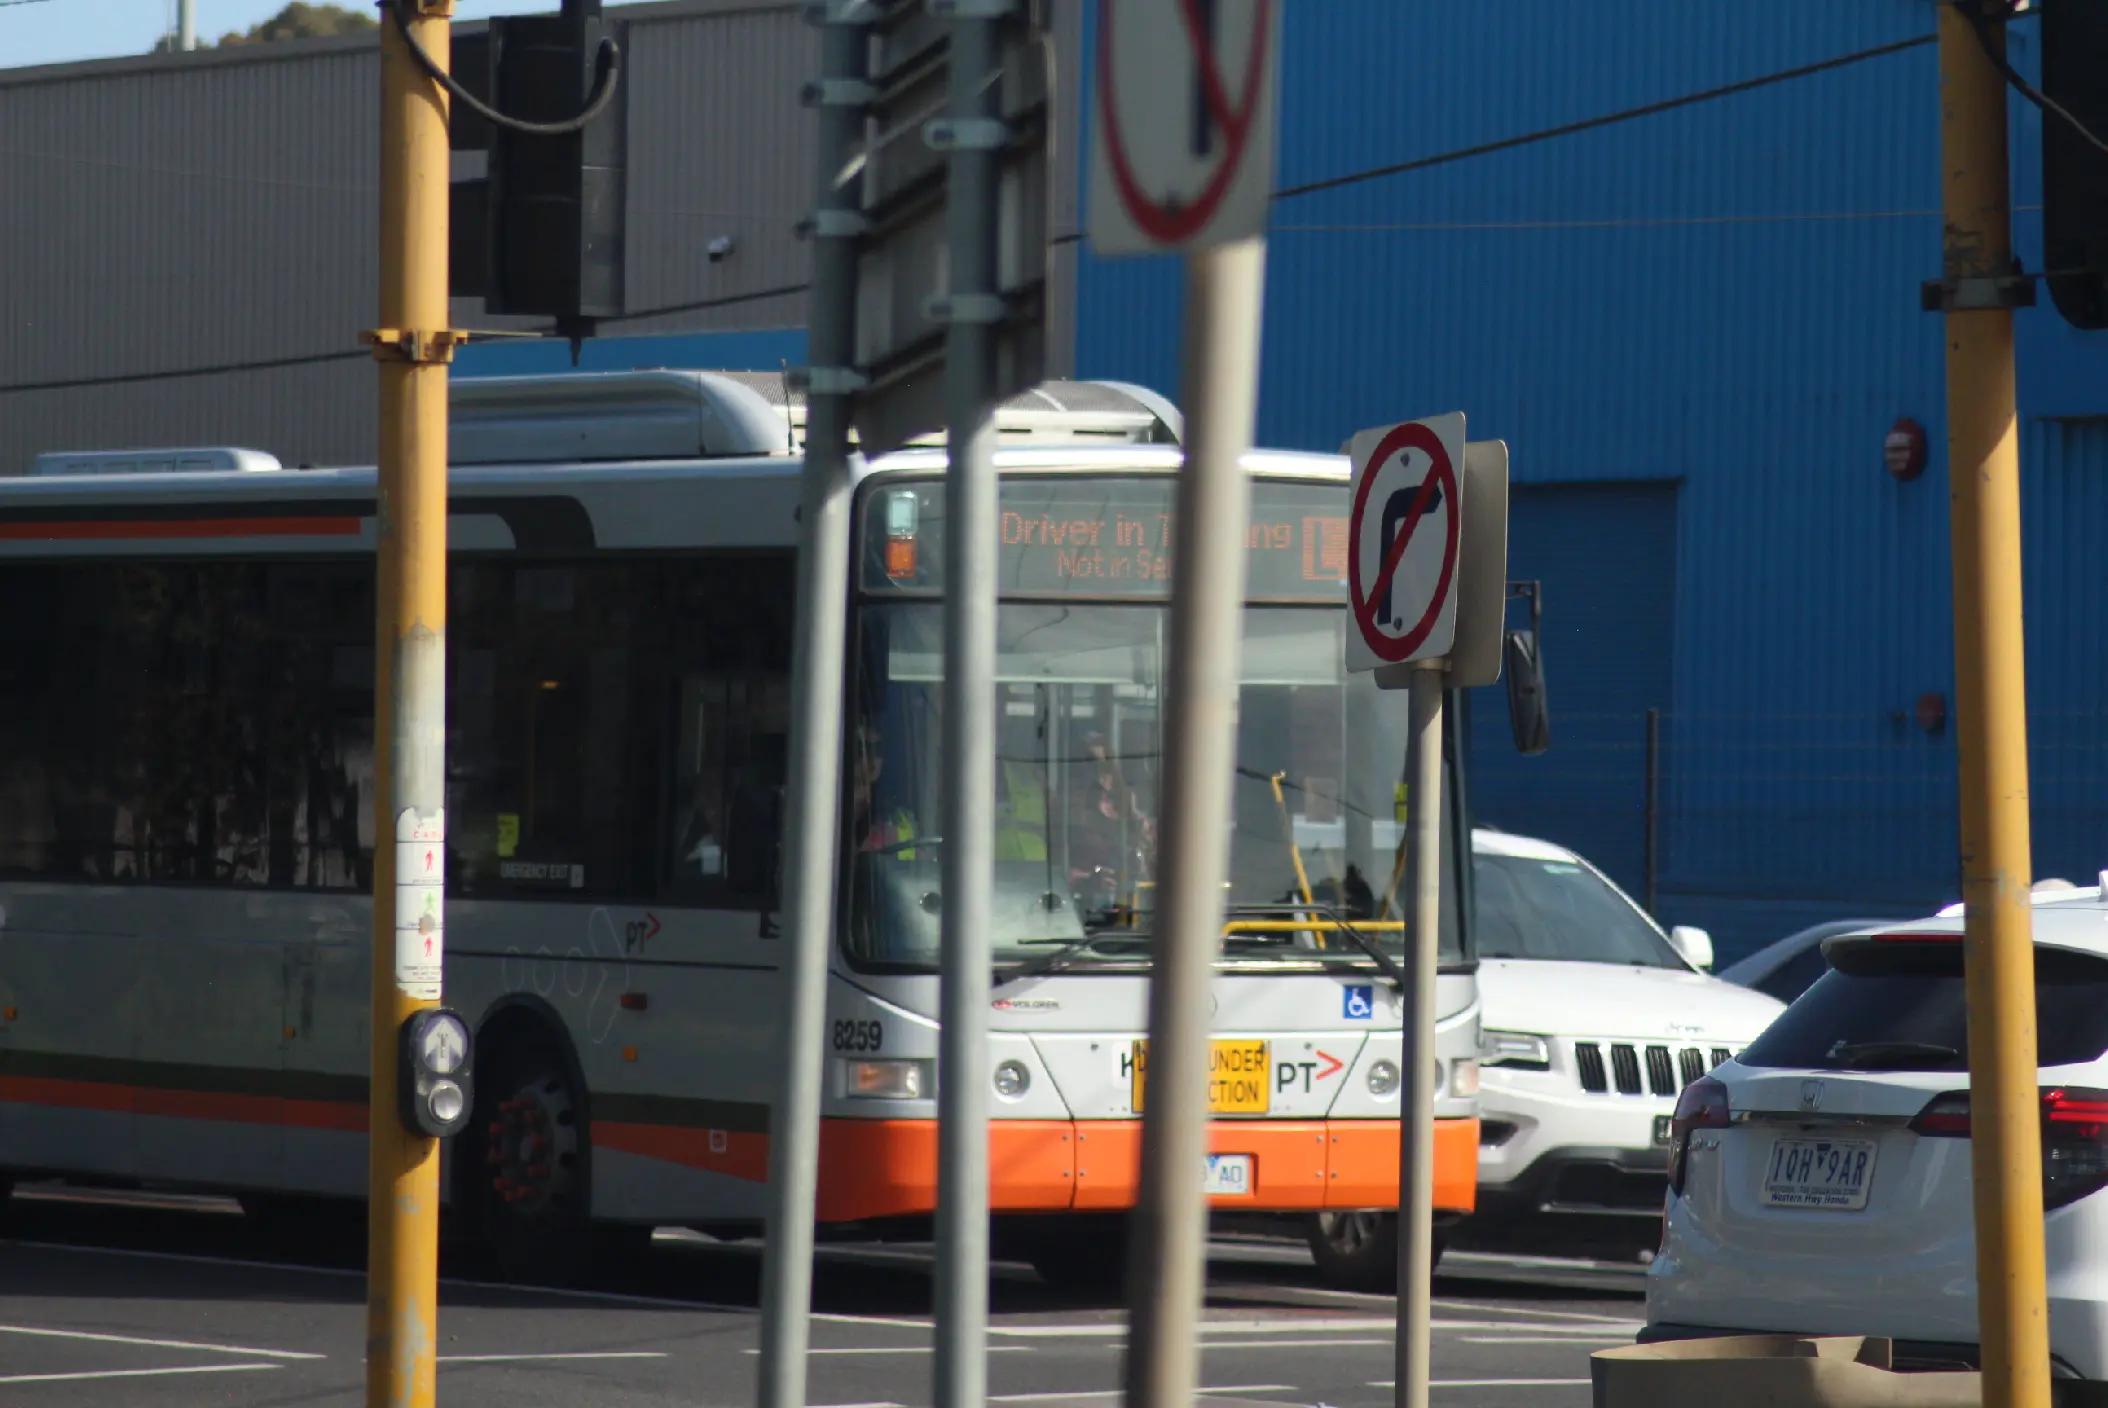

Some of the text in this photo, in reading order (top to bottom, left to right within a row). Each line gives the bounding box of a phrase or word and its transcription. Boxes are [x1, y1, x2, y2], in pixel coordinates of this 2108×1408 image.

[1000, 511, 1105, 546] Driver
[1115, 514, 1144, 547] in
[1057, 550, 1104, 579] Not
[1110, 553, 1131, 579] in
[833, 1019, 883, 1051] 8259
[1208, 1048, 1264, 1072] UNDER
[1825, 1150, 1868, 1187] 9AR
[1804, 1194, 1822, 1205] Hwy
